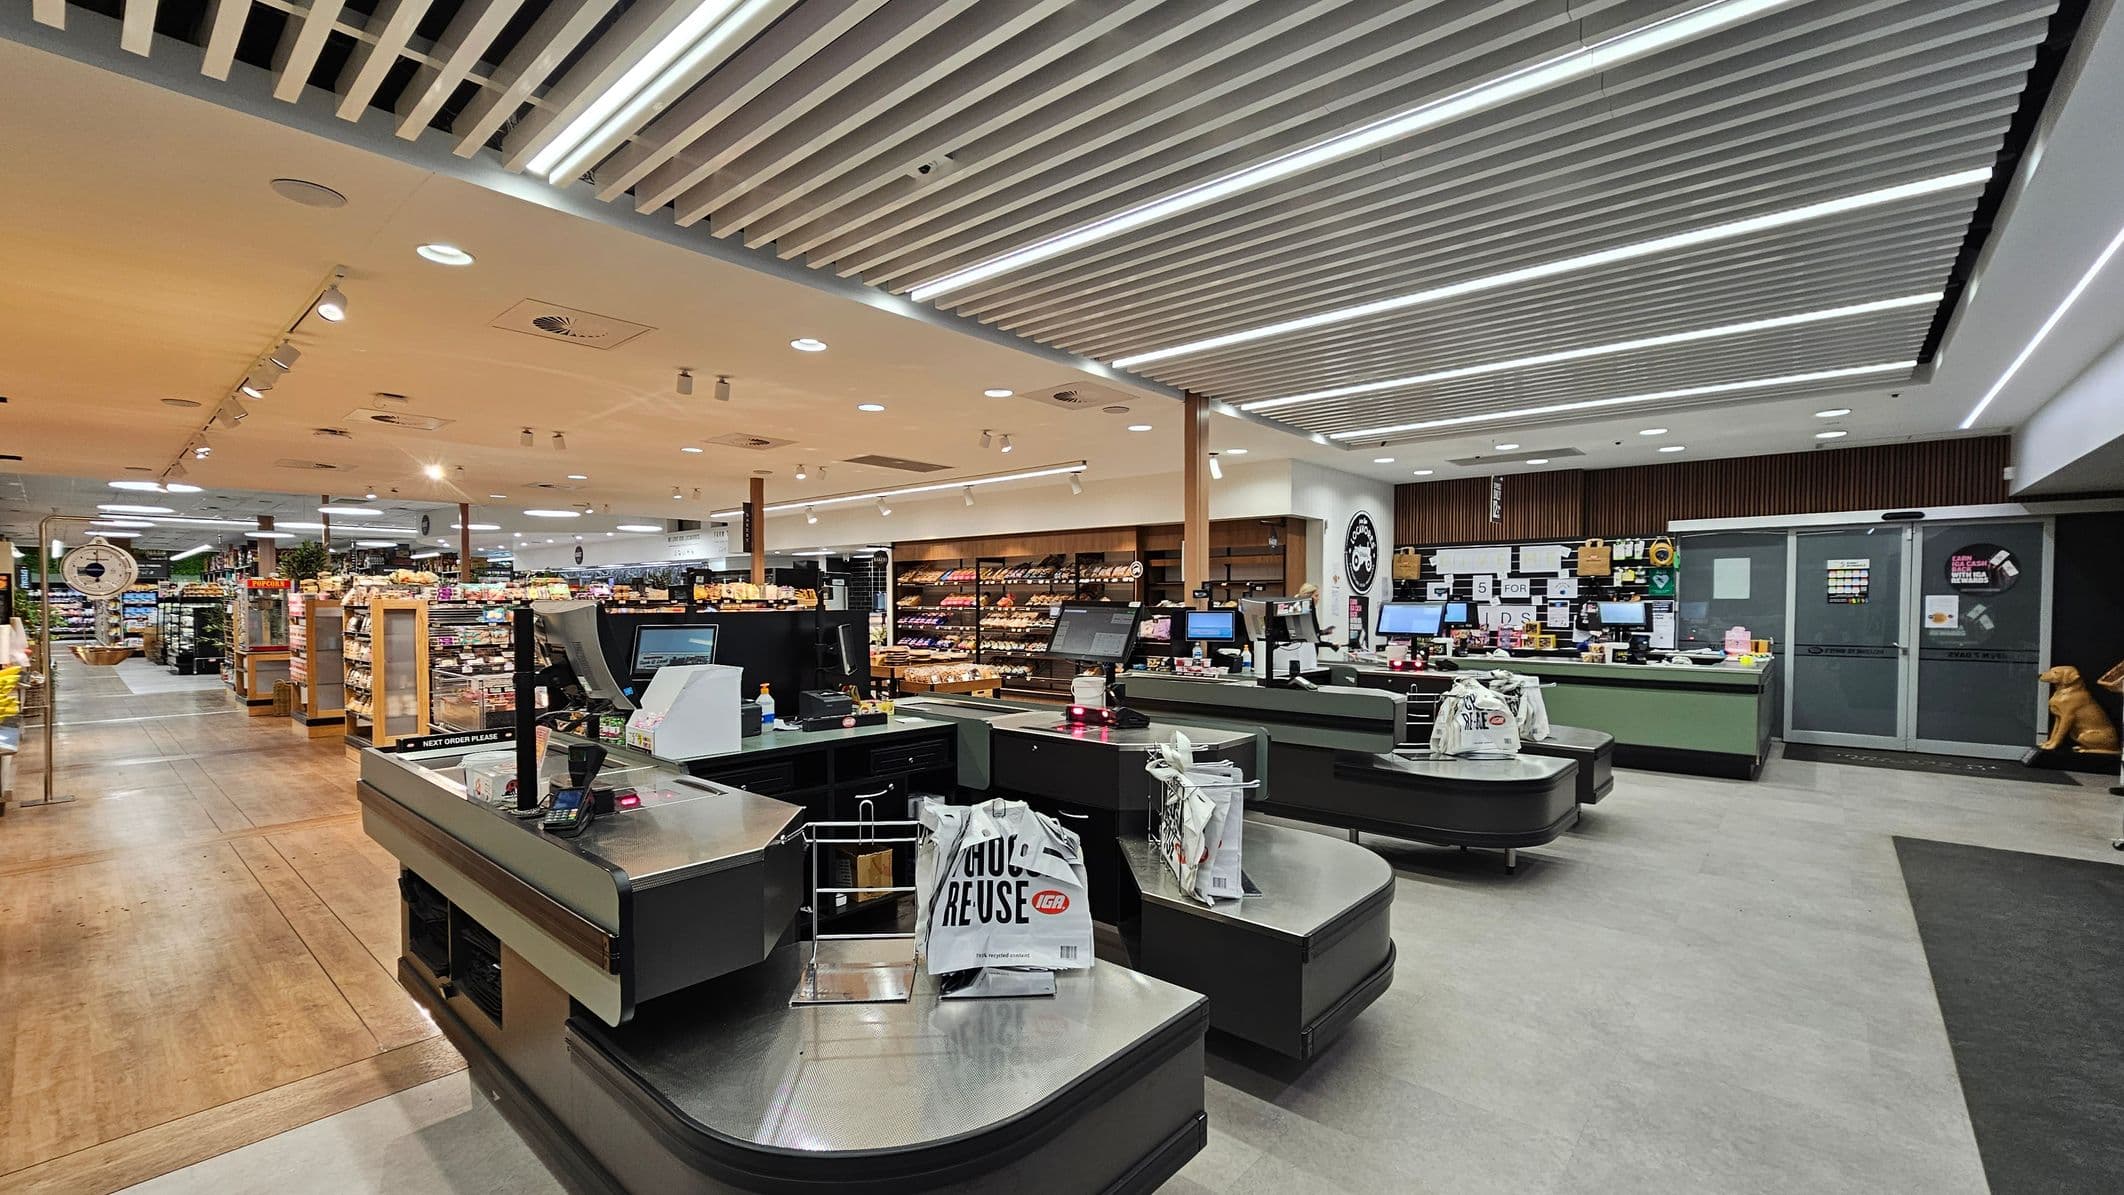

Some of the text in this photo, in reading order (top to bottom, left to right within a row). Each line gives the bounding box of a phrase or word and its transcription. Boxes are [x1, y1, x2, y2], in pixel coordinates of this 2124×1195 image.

[1478, 581, 1487, 594] 5
[1504, 583, 1527, 593] FOR
[444, 737, 470, 745] ORDER
[471, 733, 498, 741] PLEASE
[1035, 893, 1066, 910] IGA
